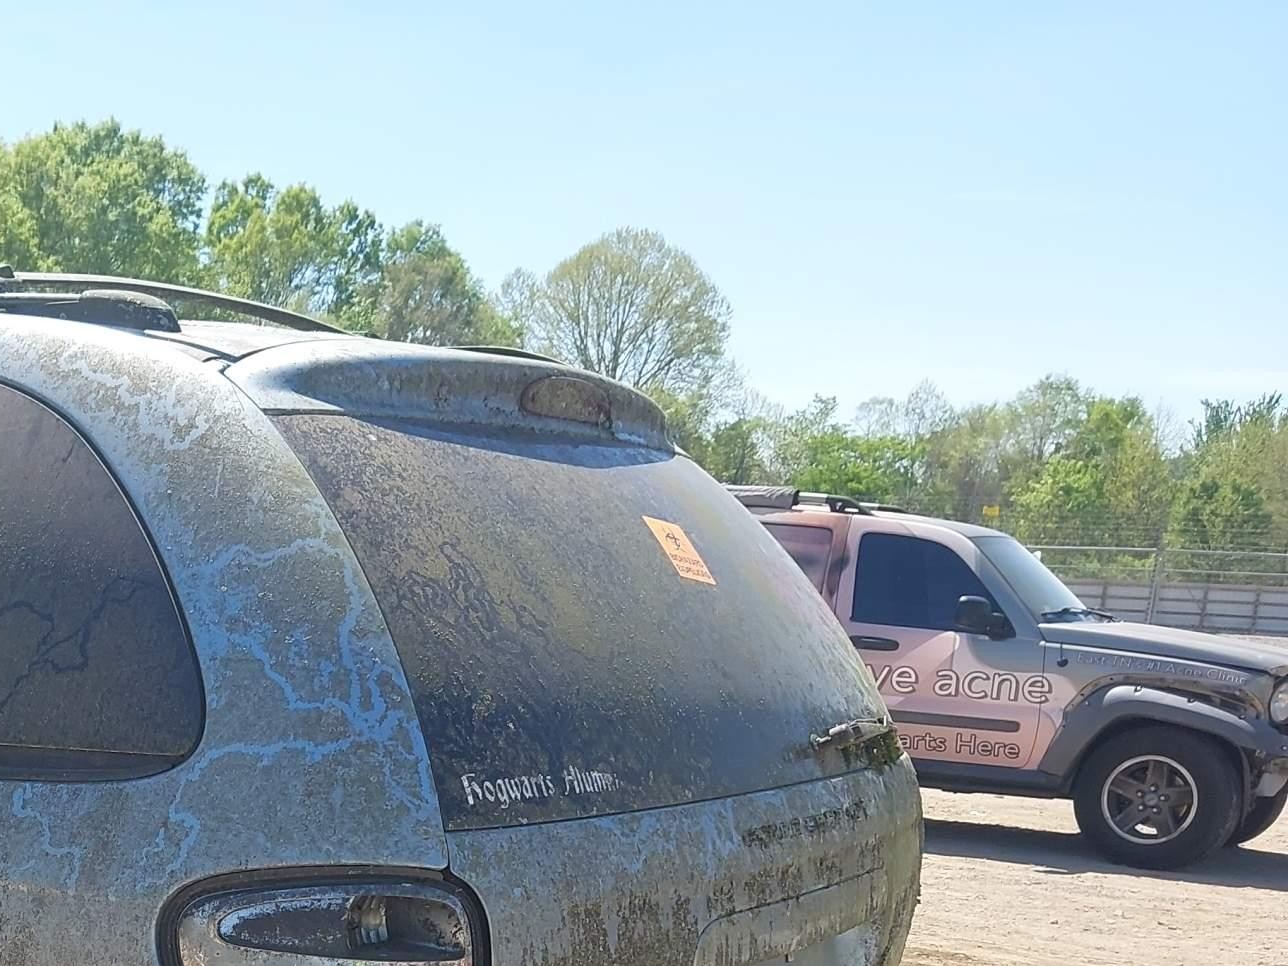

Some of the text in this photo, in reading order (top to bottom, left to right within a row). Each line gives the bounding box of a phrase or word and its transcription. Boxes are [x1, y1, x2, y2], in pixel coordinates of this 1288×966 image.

[1076, 652, 1106, 665] East
[1146, 661, 1161, 671] #1
[1206, 669, 1248, 686] Clinic
[933, 669, 1053, 704] acne
[955, 733, 1020, 759] Here
[461, 773, 555, 809] Hogwarts
